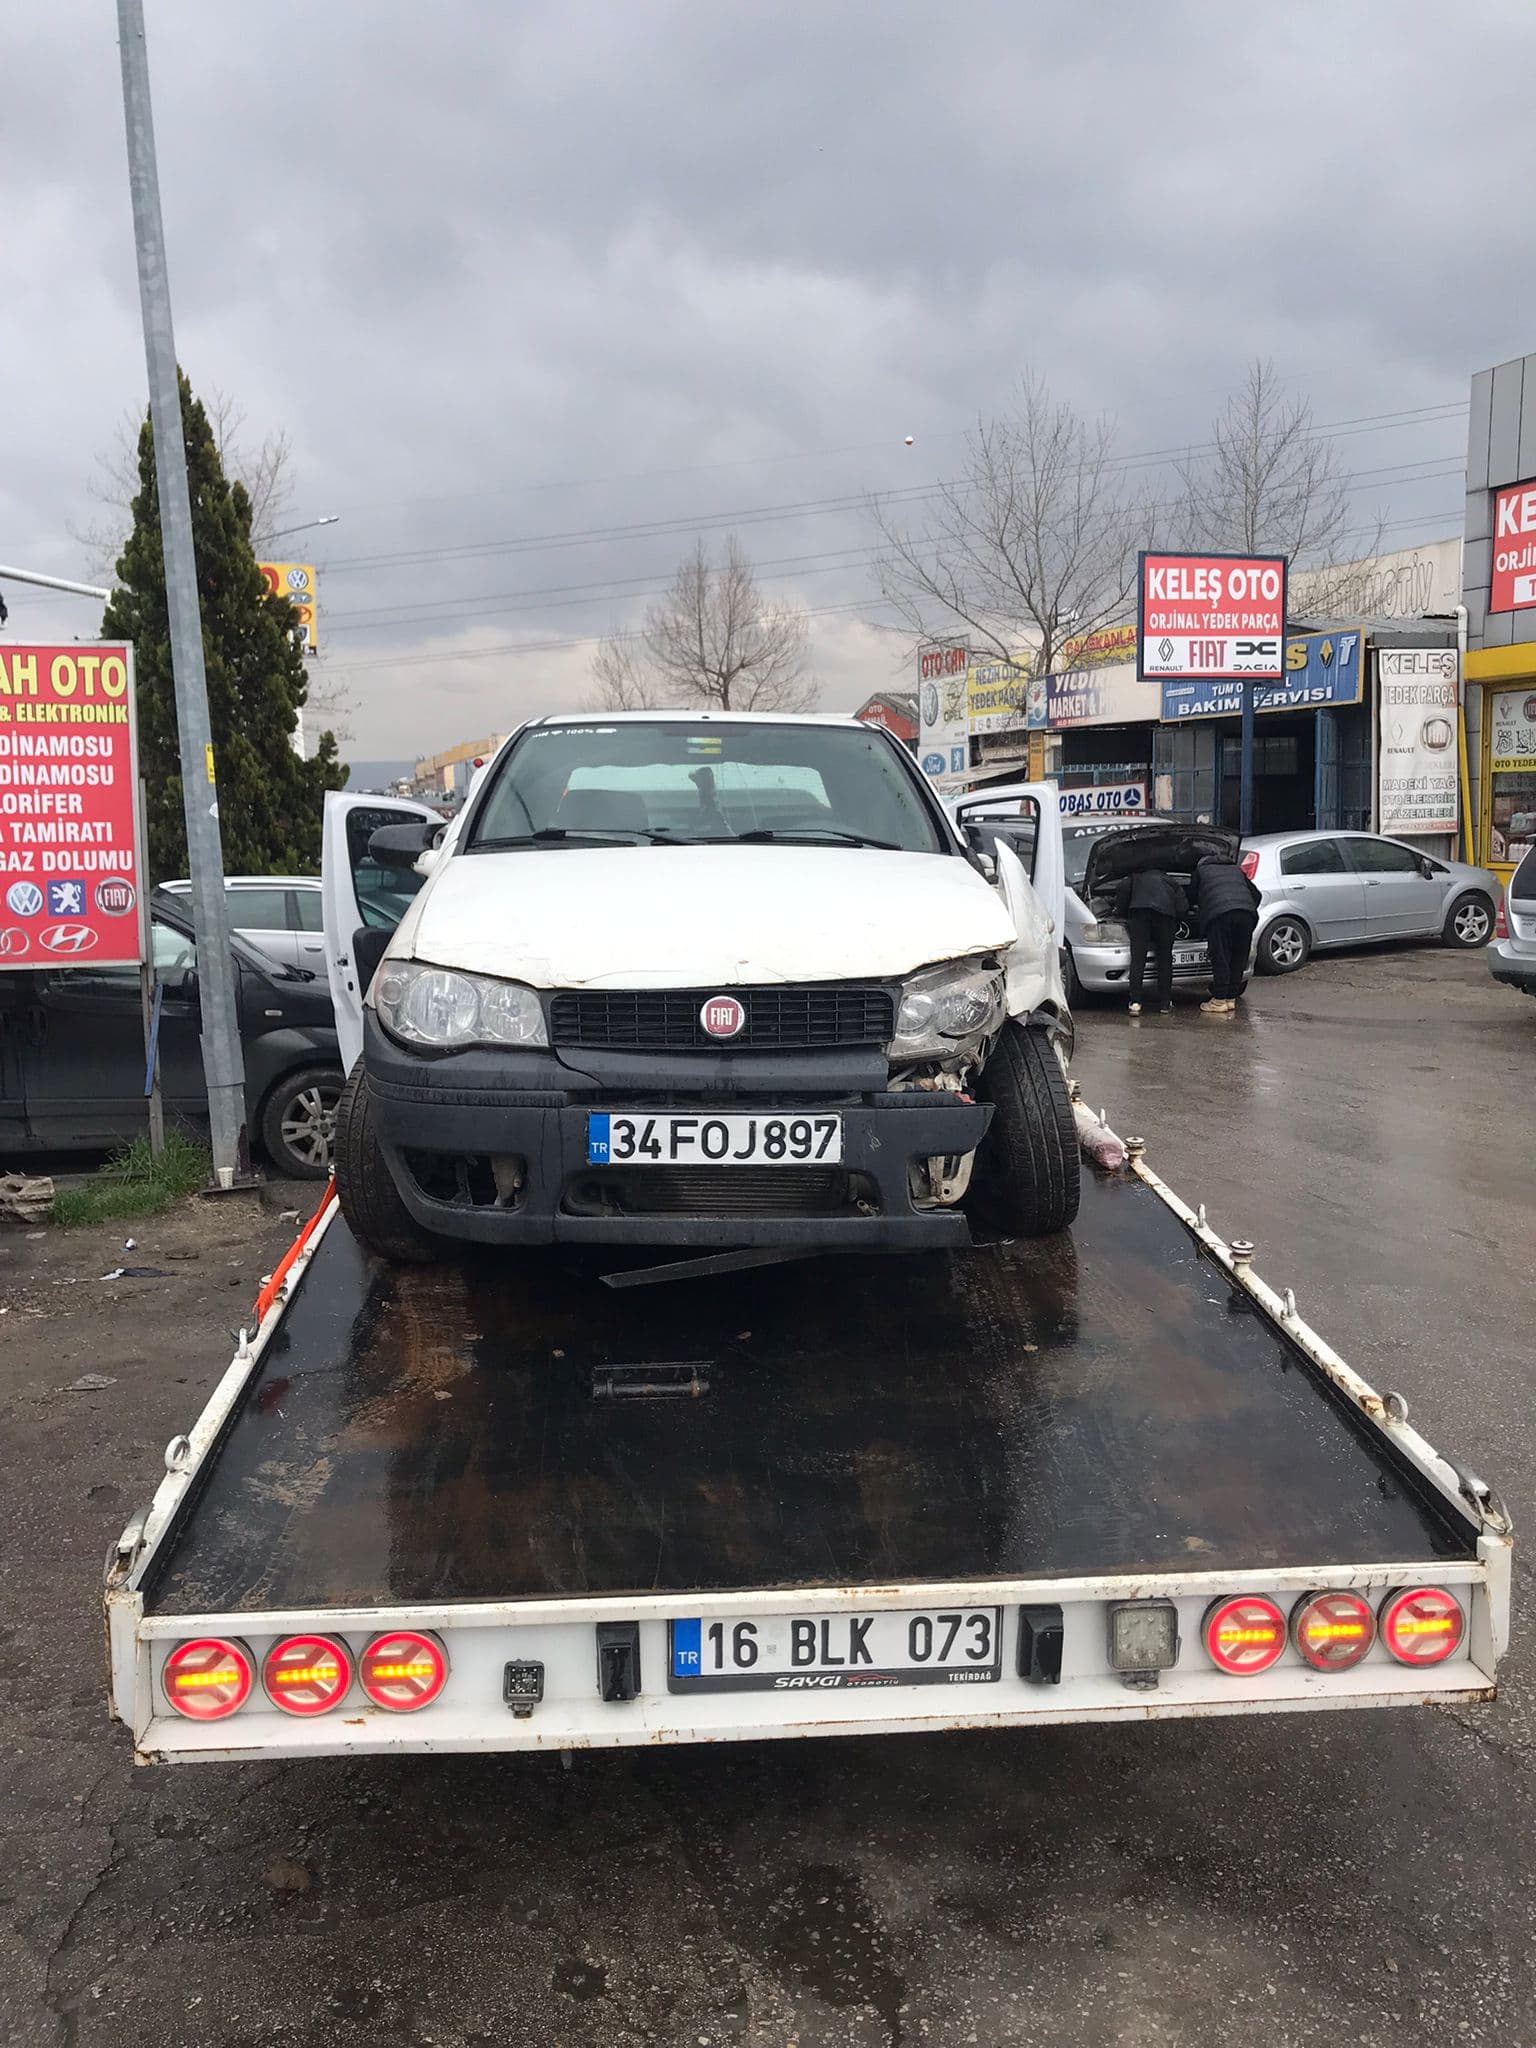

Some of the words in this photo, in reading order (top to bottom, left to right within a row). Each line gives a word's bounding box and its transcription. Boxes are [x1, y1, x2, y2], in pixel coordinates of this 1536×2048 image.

[1149, 568, 1222, 609] KELEŞ
[1228, 568, 1280, 600] OTO
[1149, 609, 1200, 630] ORJİNAL
[1202, 613, 1239, 630] YEDEK
[1242, 613, 1279, 633] PARÇA
[1189, 640, 1227, 668] FIAT
[1382, 653, 1456, 679] KELEŞ
[51, 655, 127, 698] OTO
[1048, 694, 1088, 719] MARKET
[1178, 697, 1240, 715] BAKIM
[1420, 684, 1456, 708] PARÇA
[15, 701, 128, 724] ELEKTRONİK
[0, 730, 113, 757] DİNAMOSU
[0, 759, 114, 785] DİNAMOSU
[1429, 775, 1456, 790] YAĞ
[1097, 791, 1121, 810] OTO
[9, 818, 113, 843] TAMİRATI
[42, 850, 133, 872] DOLUMU
[104, 889, 127, 906] FIAT
[711, 1007, 734, 1026] FIAT
[591, 1142, 608, 1154] TR
[678, 1651, 698, 1665] TR
[708, 1621, 759, 1669] 16
[791, 1617, 874, 1667] BLK
[908, 1614, 991, 1662] 073
[774, 1675, 842, 1689] SAYGI
[949, 1671, 992, 1682] TEKİRDAĞ
